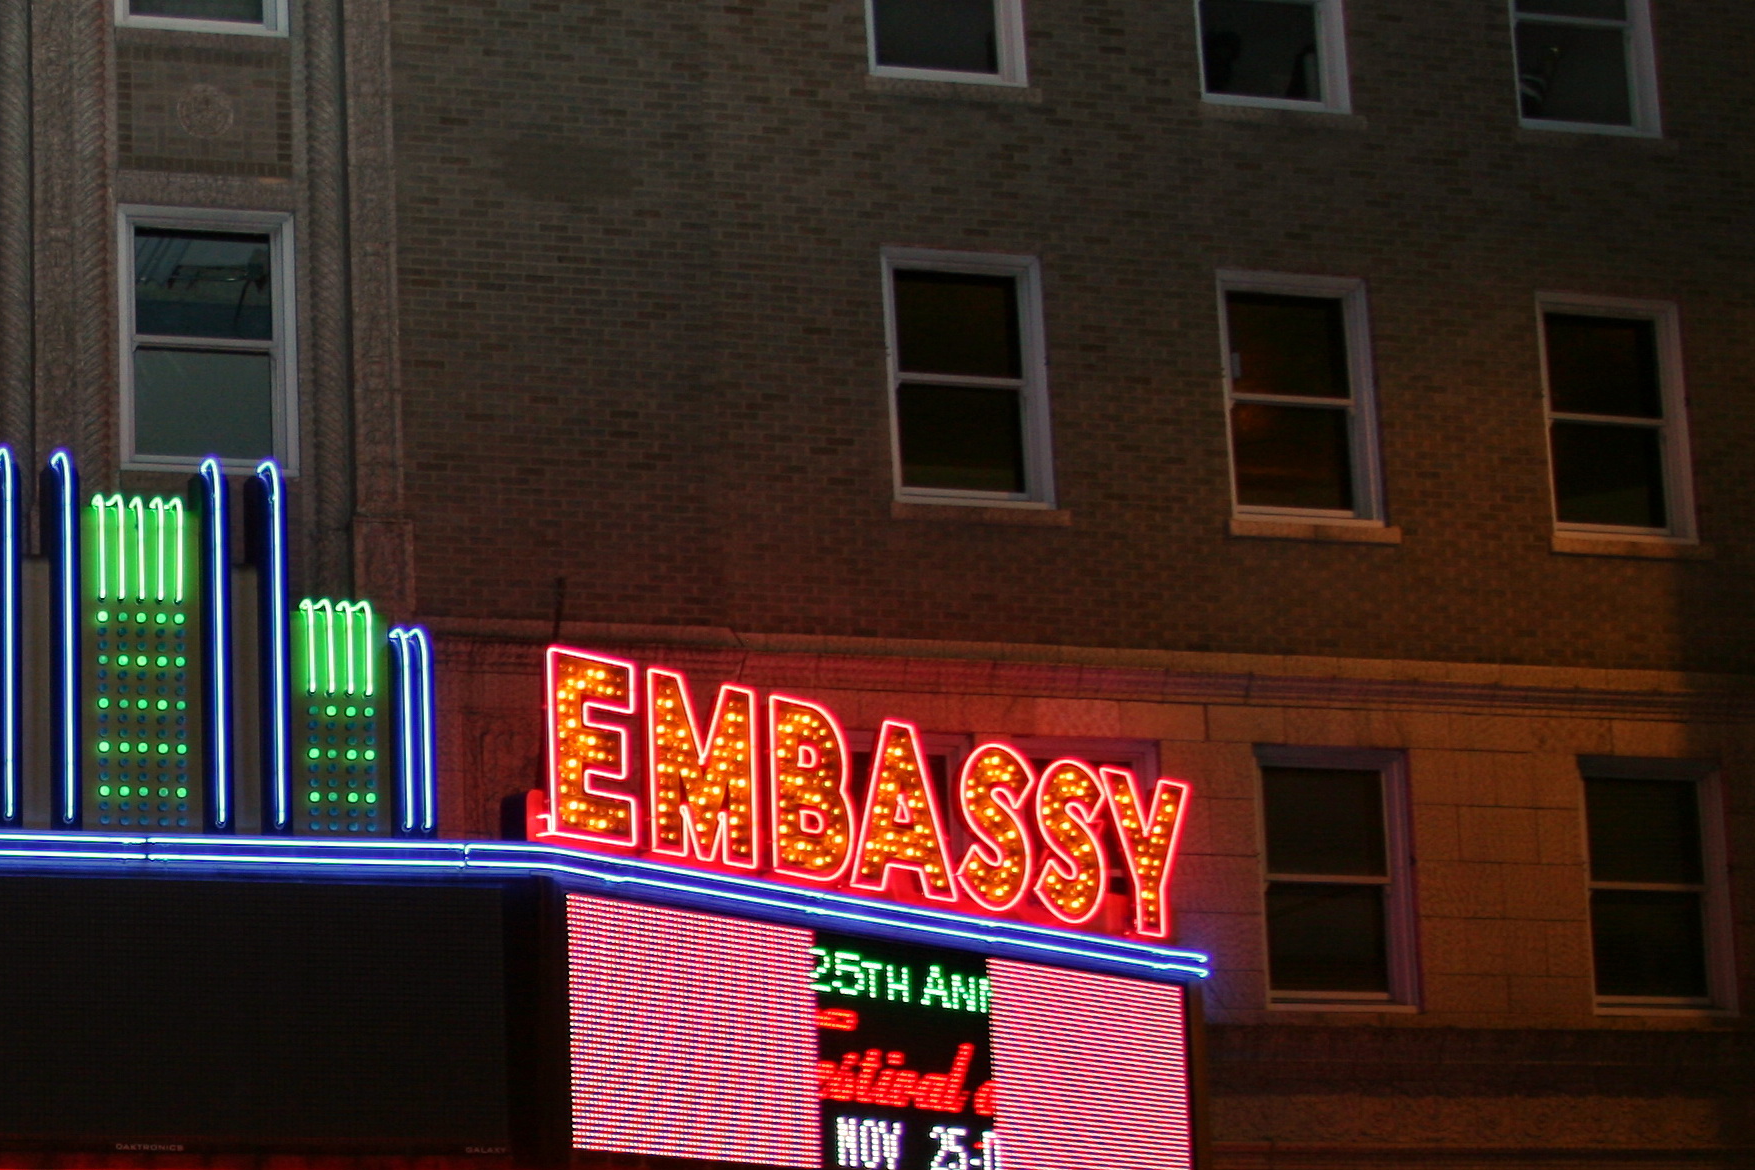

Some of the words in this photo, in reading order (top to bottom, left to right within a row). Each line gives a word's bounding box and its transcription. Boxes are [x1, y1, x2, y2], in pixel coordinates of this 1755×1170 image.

[546, 646, 1190, 938] EMBASSY
[808, 947, 911, 1004] 25TH
[465, 1145, 507, 1154] GALAXY
